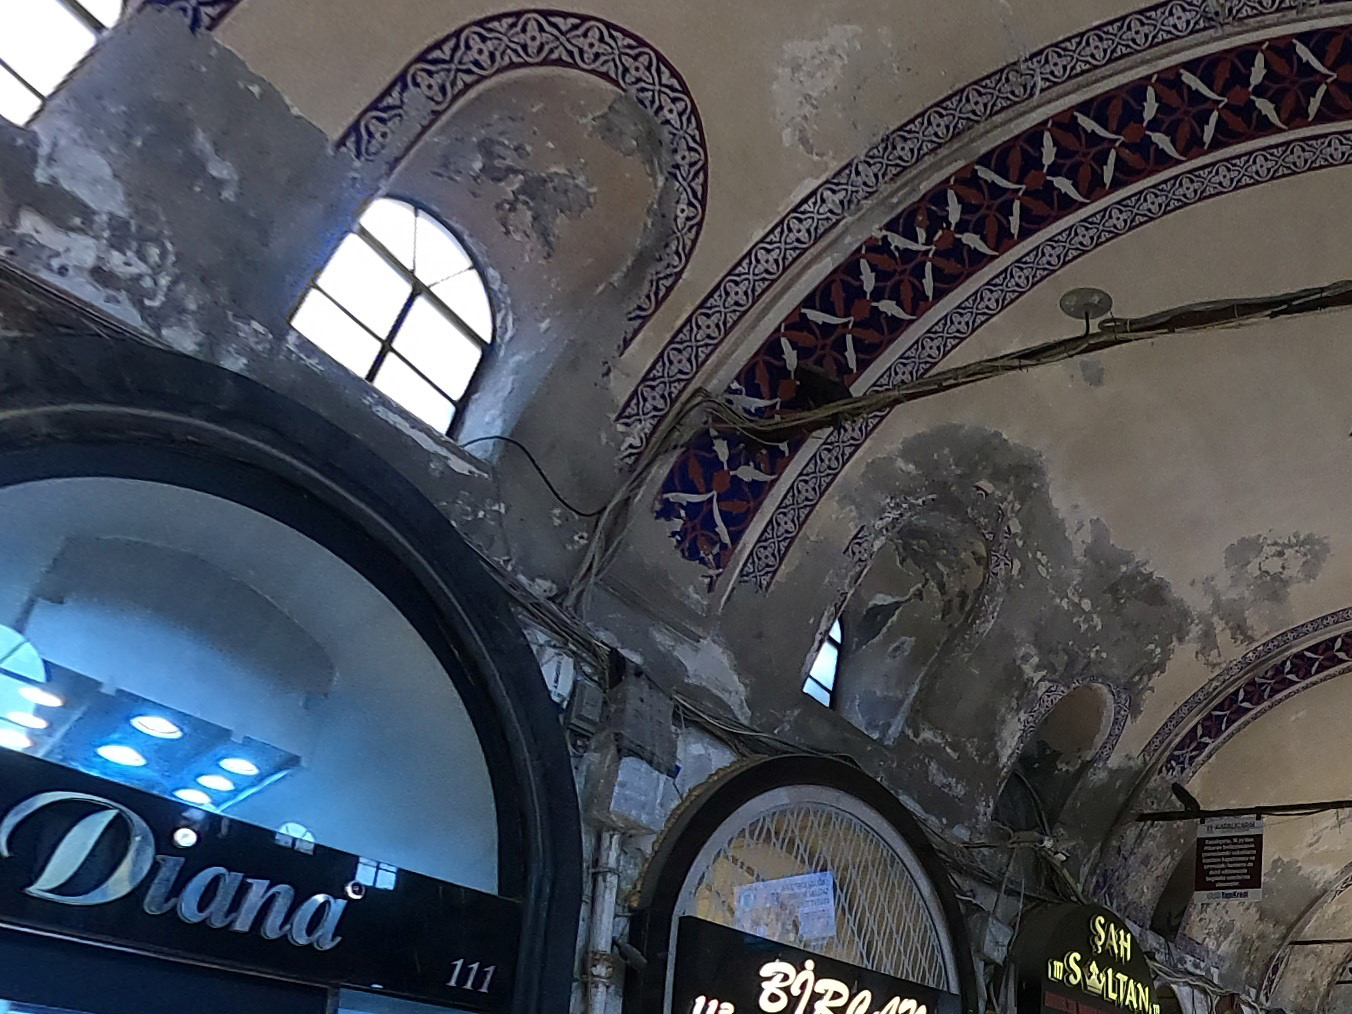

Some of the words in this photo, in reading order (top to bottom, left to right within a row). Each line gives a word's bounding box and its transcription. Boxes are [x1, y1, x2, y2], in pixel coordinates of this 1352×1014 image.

[0, 790, 347, 951] Diana
[1091, 915, 1132, 961] ŞAH
[445, 957, 496, 994] 111
